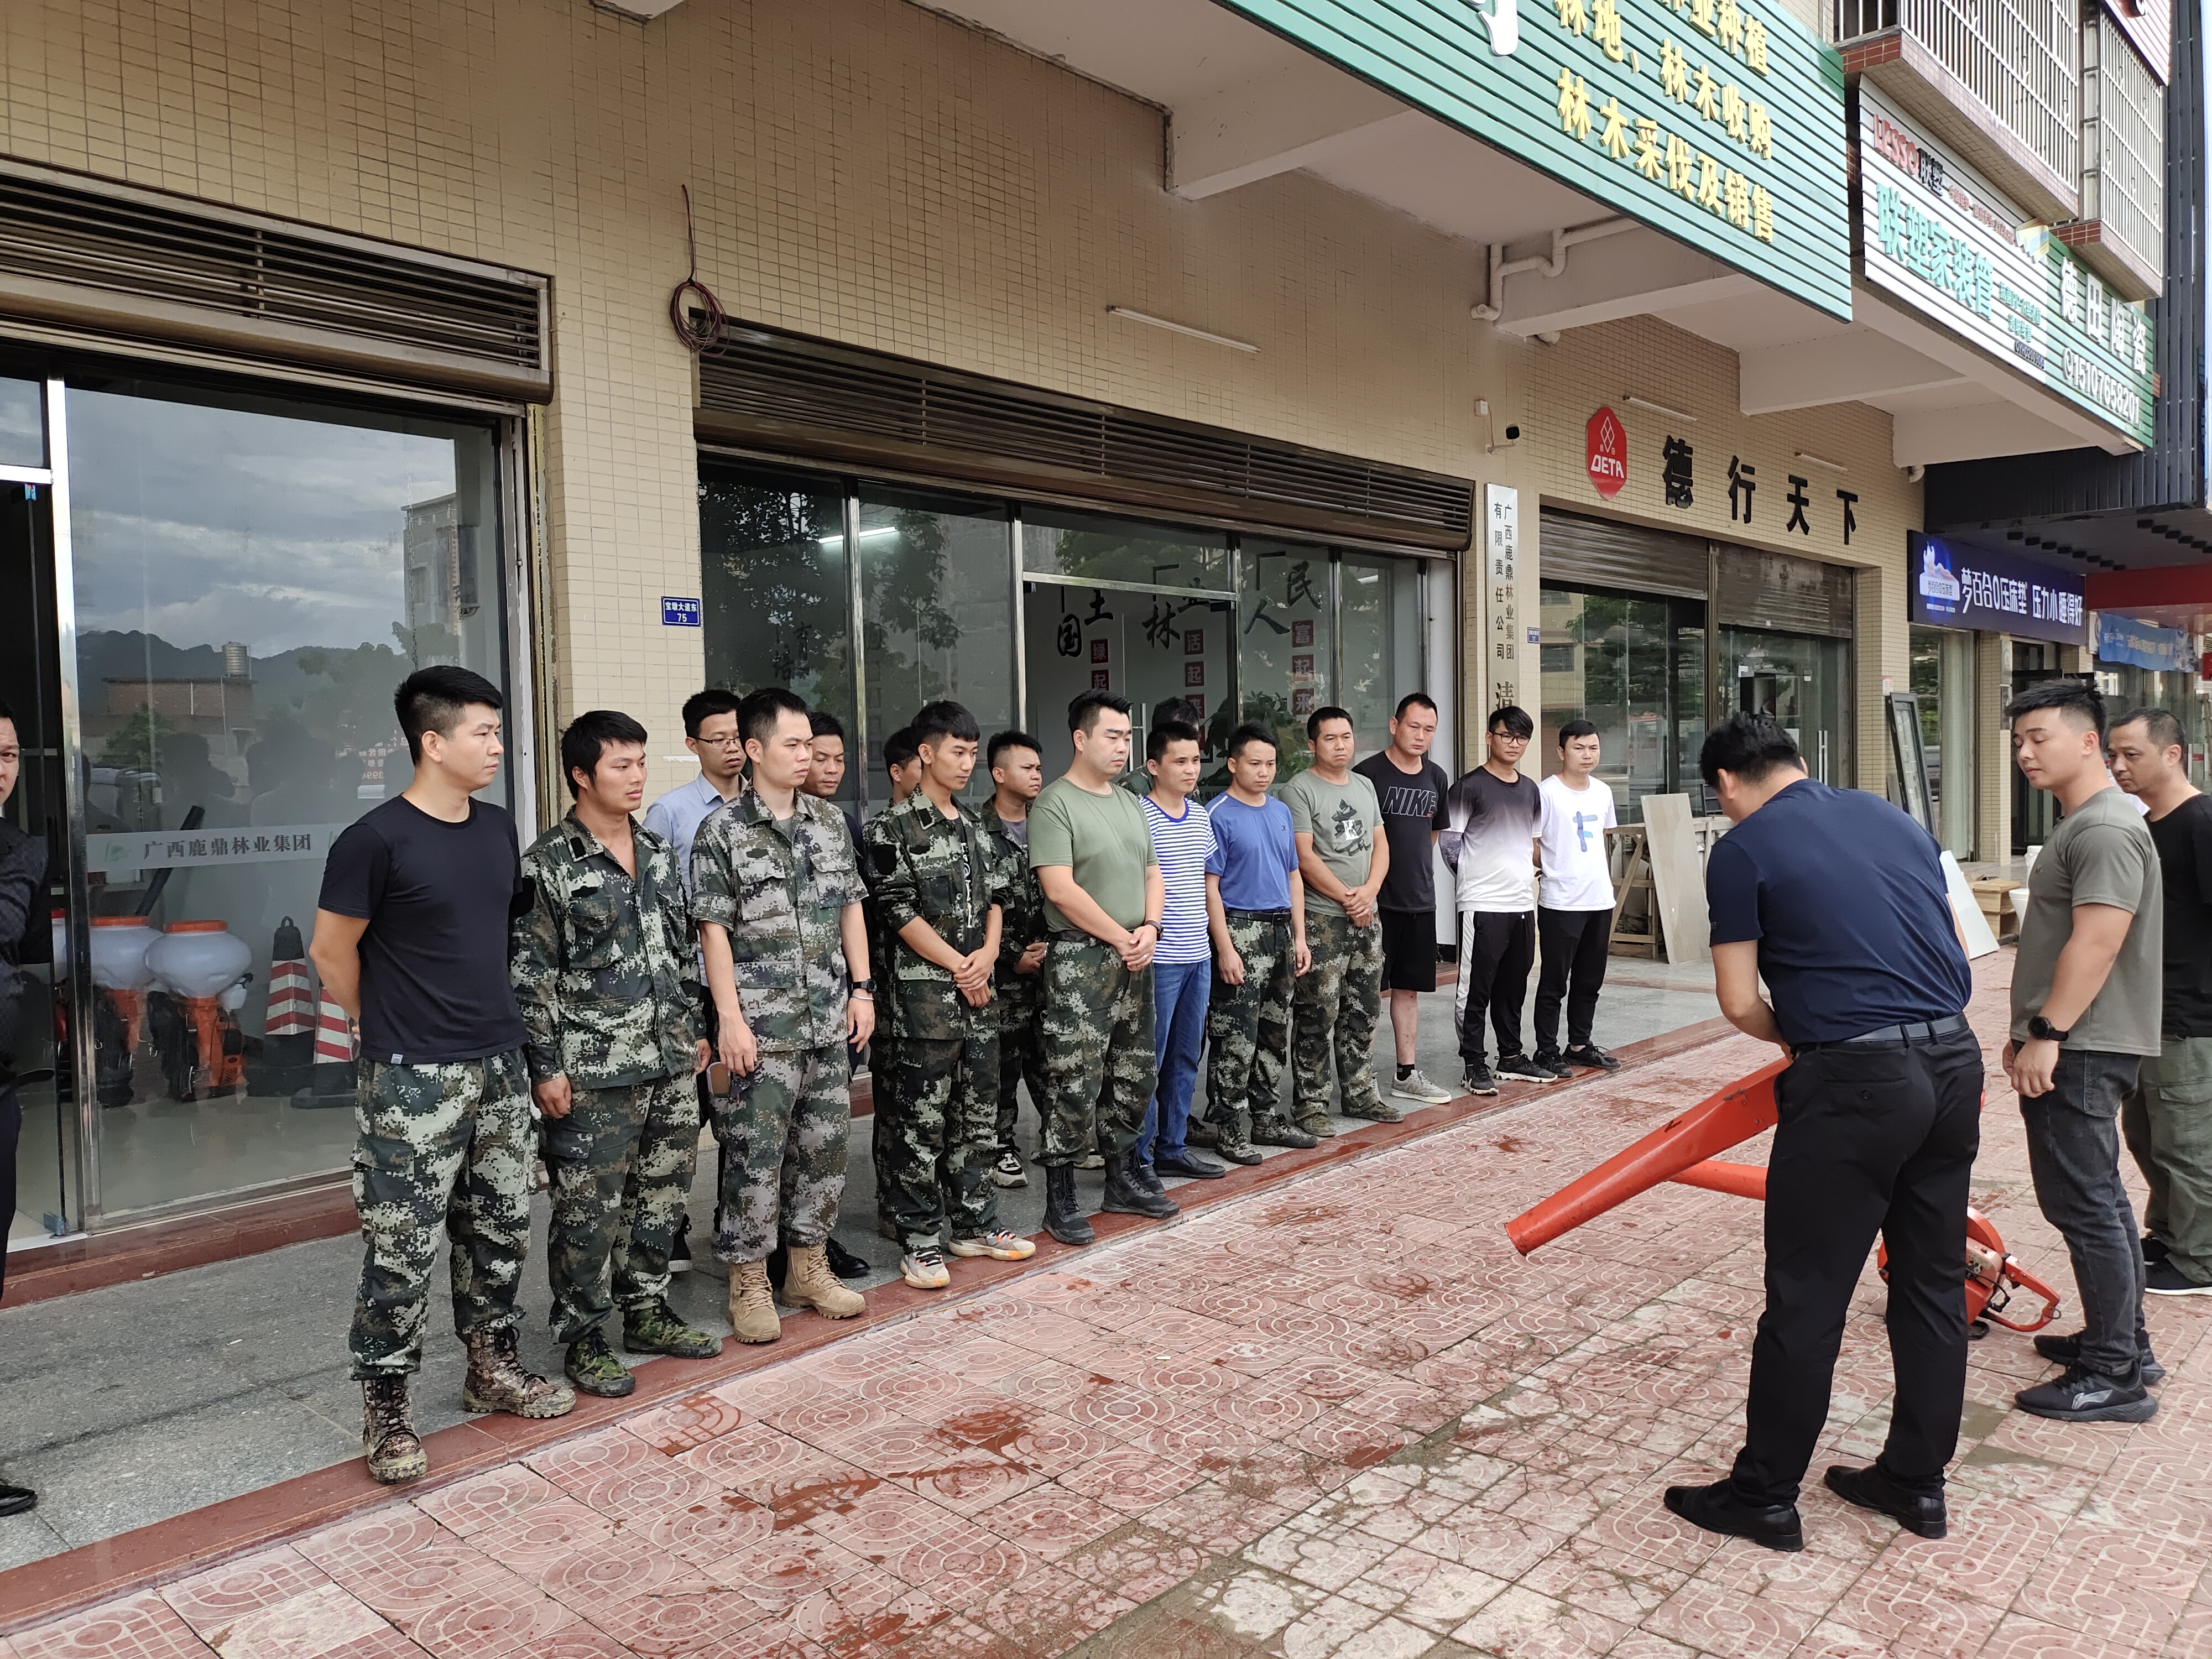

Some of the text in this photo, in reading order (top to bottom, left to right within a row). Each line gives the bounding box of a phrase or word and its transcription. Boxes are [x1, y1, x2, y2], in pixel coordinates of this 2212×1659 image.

[1662, 0, 1768, 76] 业种植
[1557, 67, 1773, 243] 林木采伐及销售
[1874, 114, 1943, 196] LESSO 联塑
[1876, 183, 1993, 320] 联塑家装管
[2060, 257, 2146, 375] 德田陶瓷
[1590, 454, 1625, 479] DETA
[1662, 435, 1858, 545] 德行天下
[677, 613, 687, 623] 75
[1494, 502, 1504, 660] 有限责任公司
[1504, 504, 1515, 661] 广西鹿鼎林业集团
[2032, 585, 2083, 627] 压力小睡得好
[1381, 786, 1436, 817] NIKE
[143, 833, 311, 860] 广西鹿鼎林业集团
